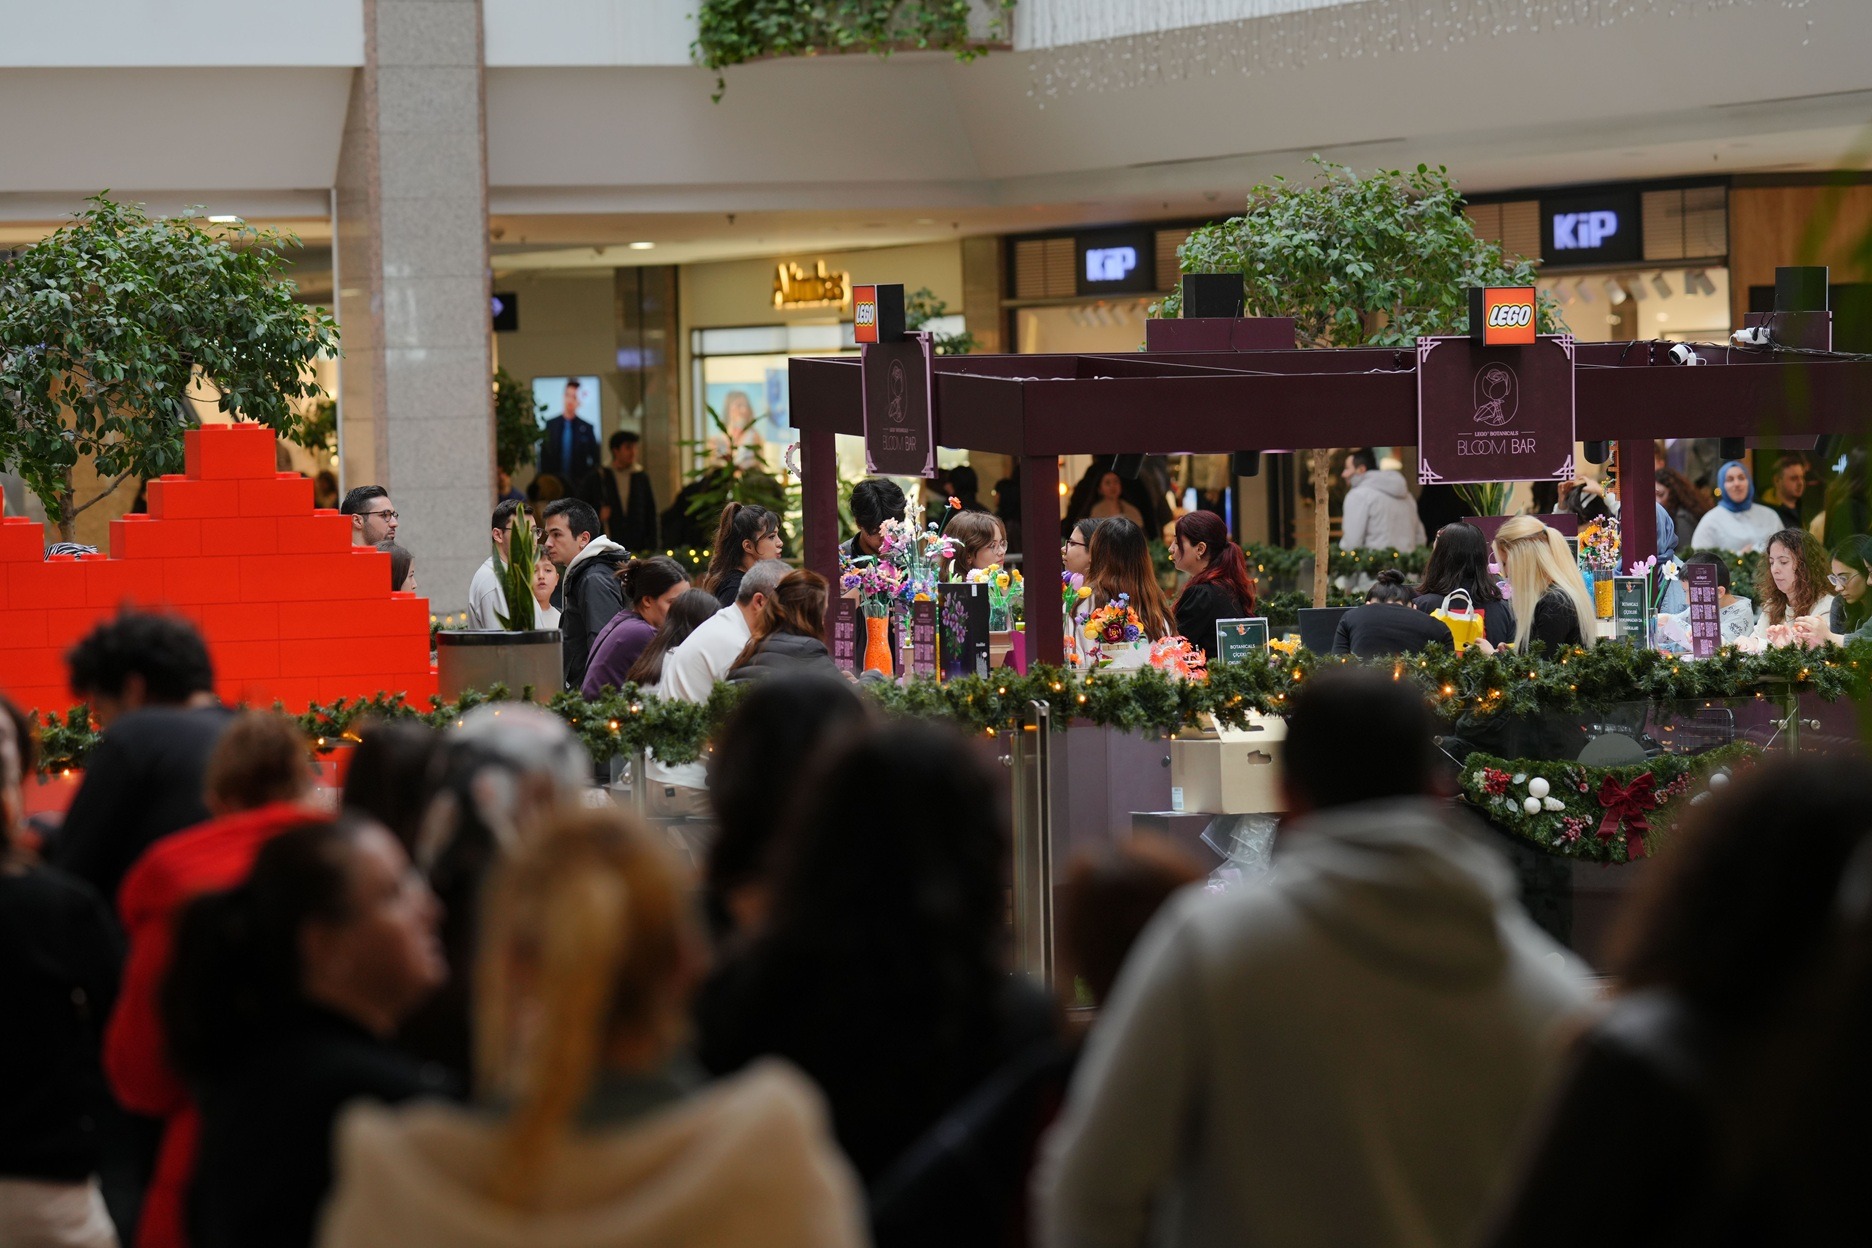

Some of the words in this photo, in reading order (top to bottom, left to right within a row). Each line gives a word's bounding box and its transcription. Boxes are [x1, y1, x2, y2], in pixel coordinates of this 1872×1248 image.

[856, 303, 875, 325] LEGO
[1488, 303, 1533, 328] LEGO
[882, 434, 904, 450] BLOOM
[905, 435, 917, 451] BAR
[1457, 440, 1506, 456] BLOOM
[1511, 438, 1536, 454] BAR
